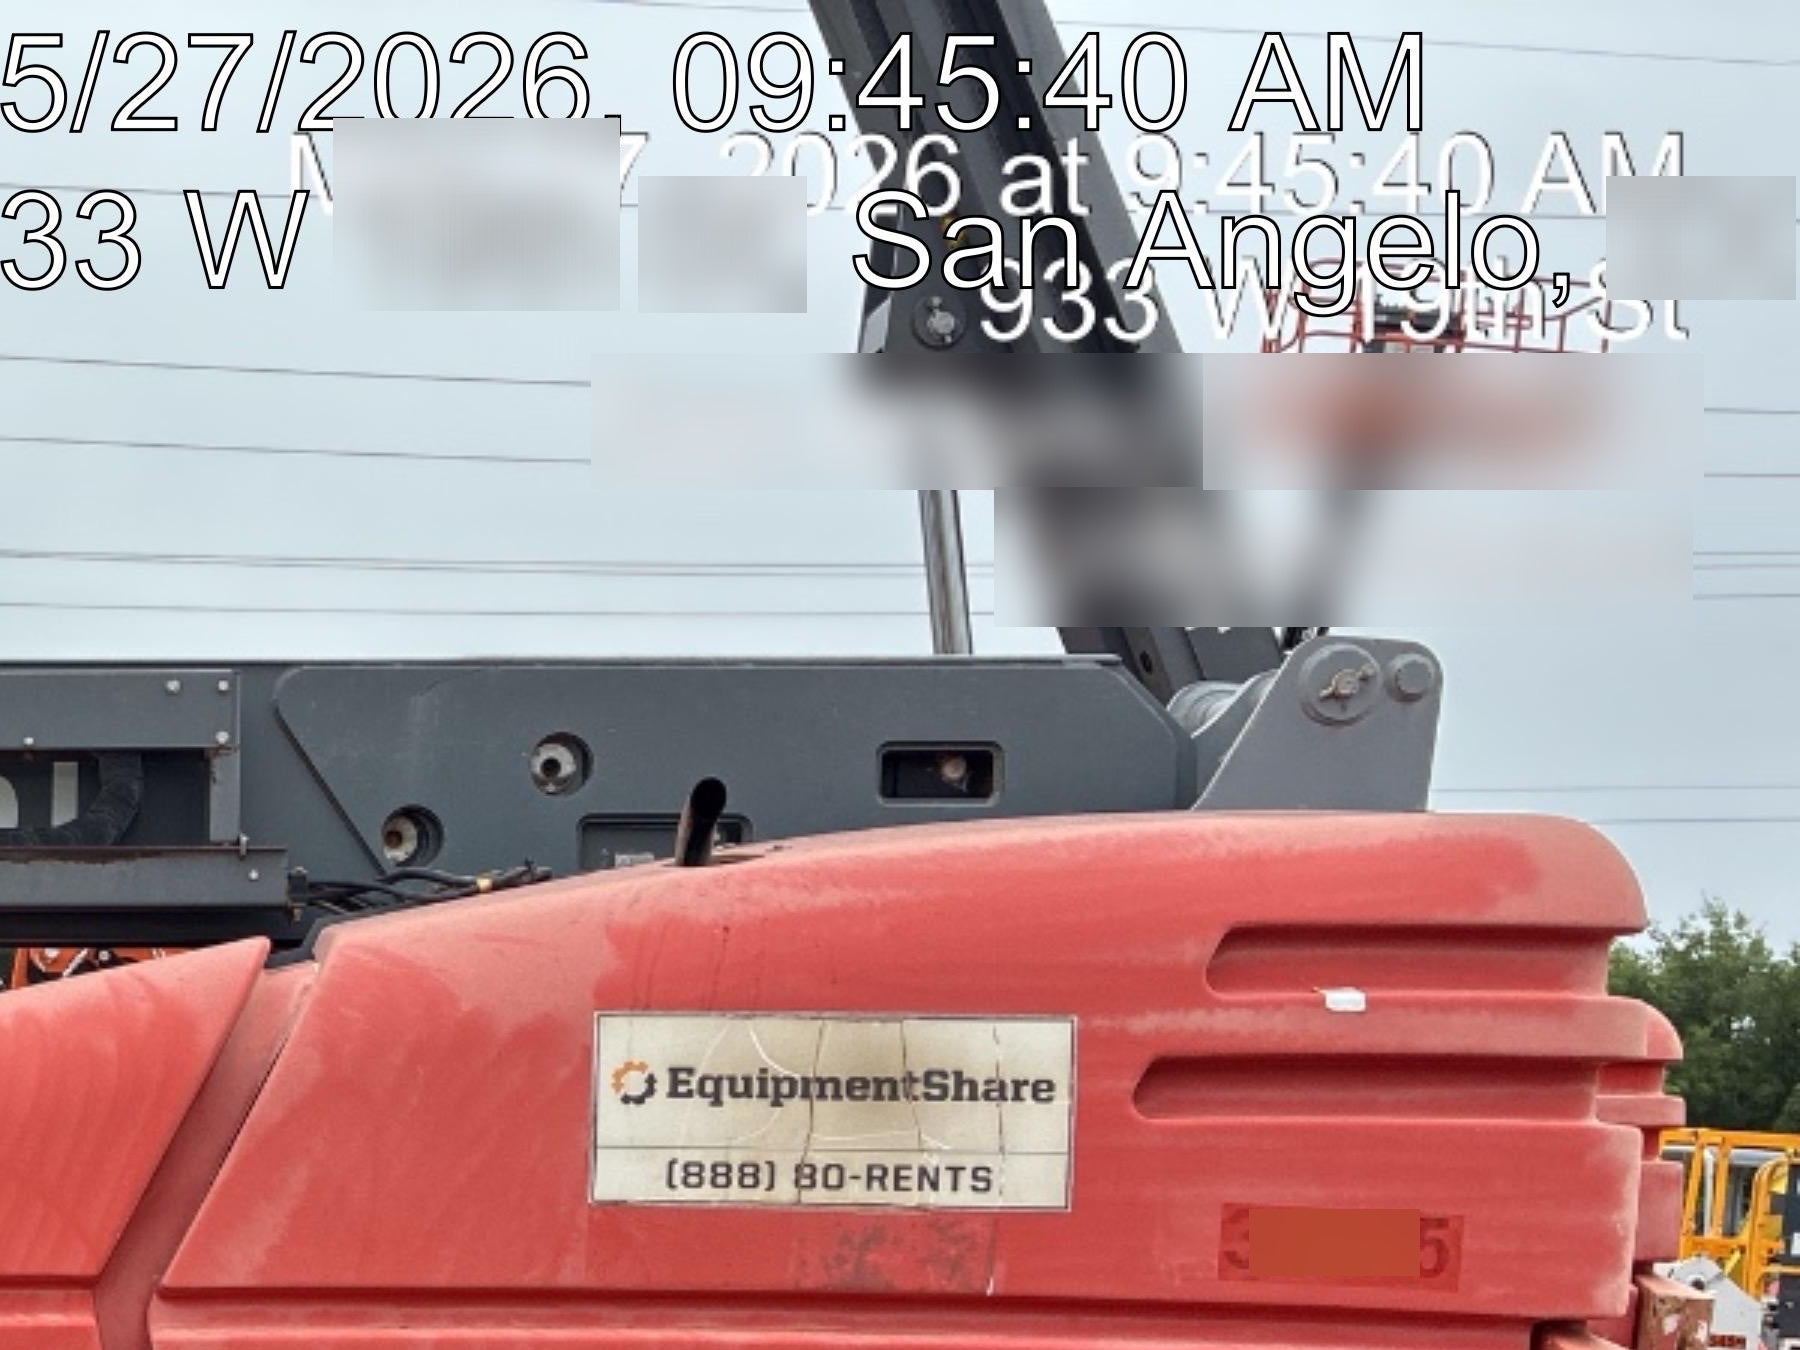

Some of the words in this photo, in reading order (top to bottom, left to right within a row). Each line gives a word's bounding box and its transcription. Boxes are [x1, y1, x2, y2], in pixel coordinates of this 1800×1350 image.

[665, 1067, 1057, 1109] EquipmentShare
[665, 1157, 777, 1193] (888)
[793, 1163, 994, 1194] 80-RENTS
